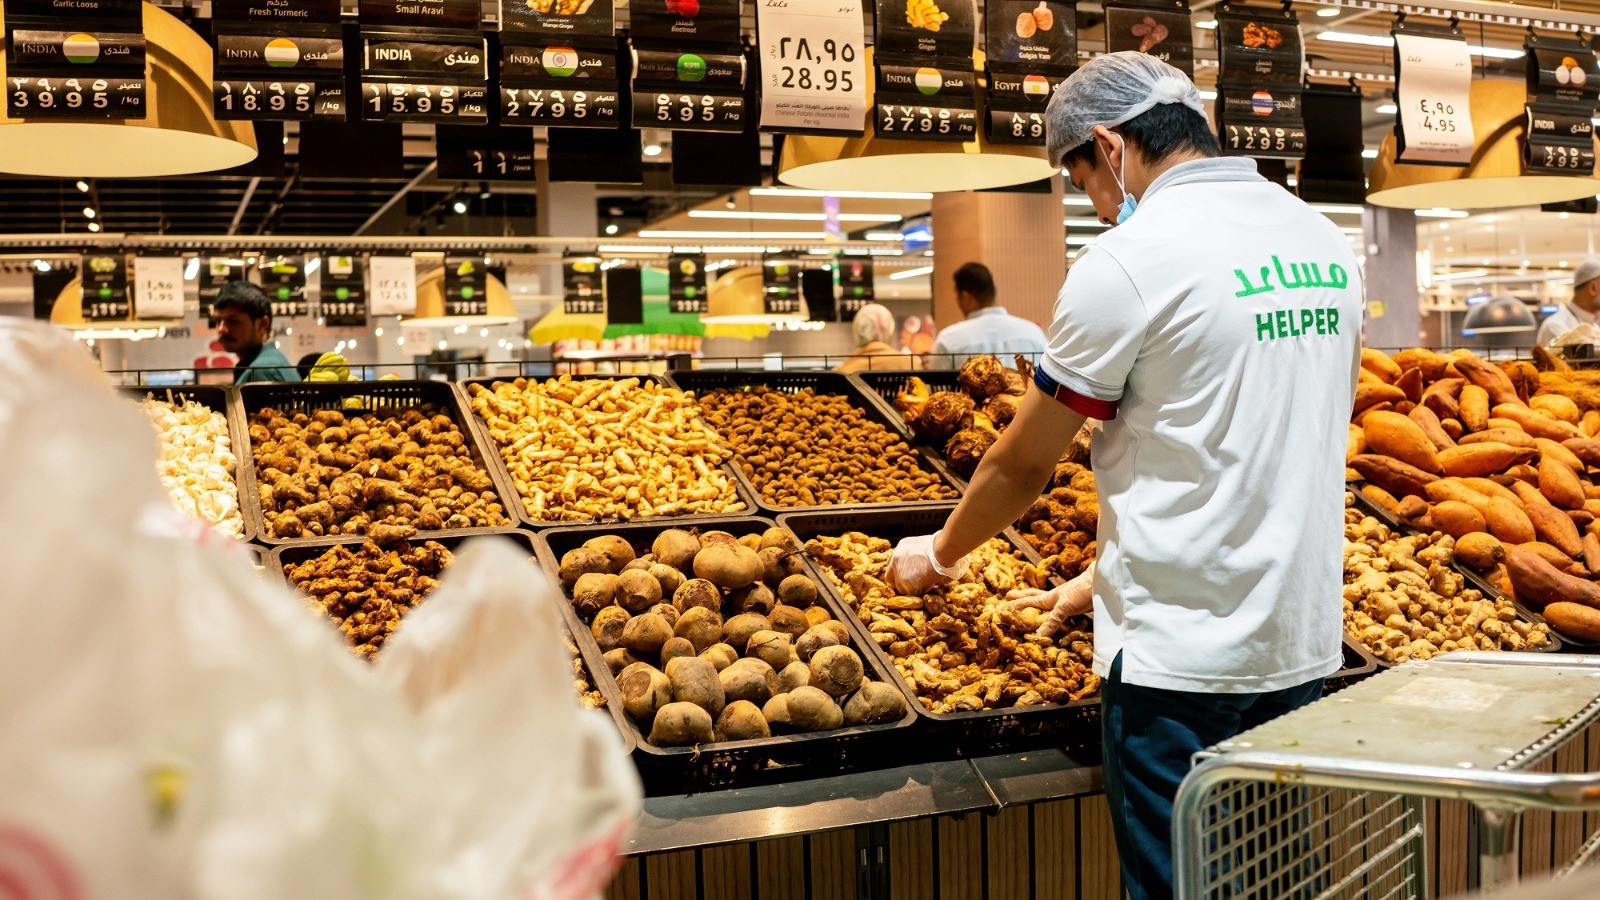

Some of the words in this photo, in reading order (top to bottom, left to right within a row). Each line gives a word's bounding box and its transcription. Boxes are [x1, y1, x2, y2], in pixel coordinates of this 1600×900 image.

[273, 8, 308, 17] Turmeric
[396, 5, 419, 14] Small
[422, 6, 444, 15] Aravi
[22, 43, 57, 54] INDIA
[226, 49, 259, 58] INDIA
[375, 49, 412, 60] INDIA
[511, 54, 539, 64] INDIA
[782, 66, 853, 92] 28.95
[887, 74, 912, 83] INDIA
[994, 81, 1021, 90] EGYPT
[1424, 116, 1455, 132] 4.95
[1534, 120, 1555, 130] INDIA
[1234, 255, 1348, 297] مساعد
[1256, 308, 1339, 341] HELPER
